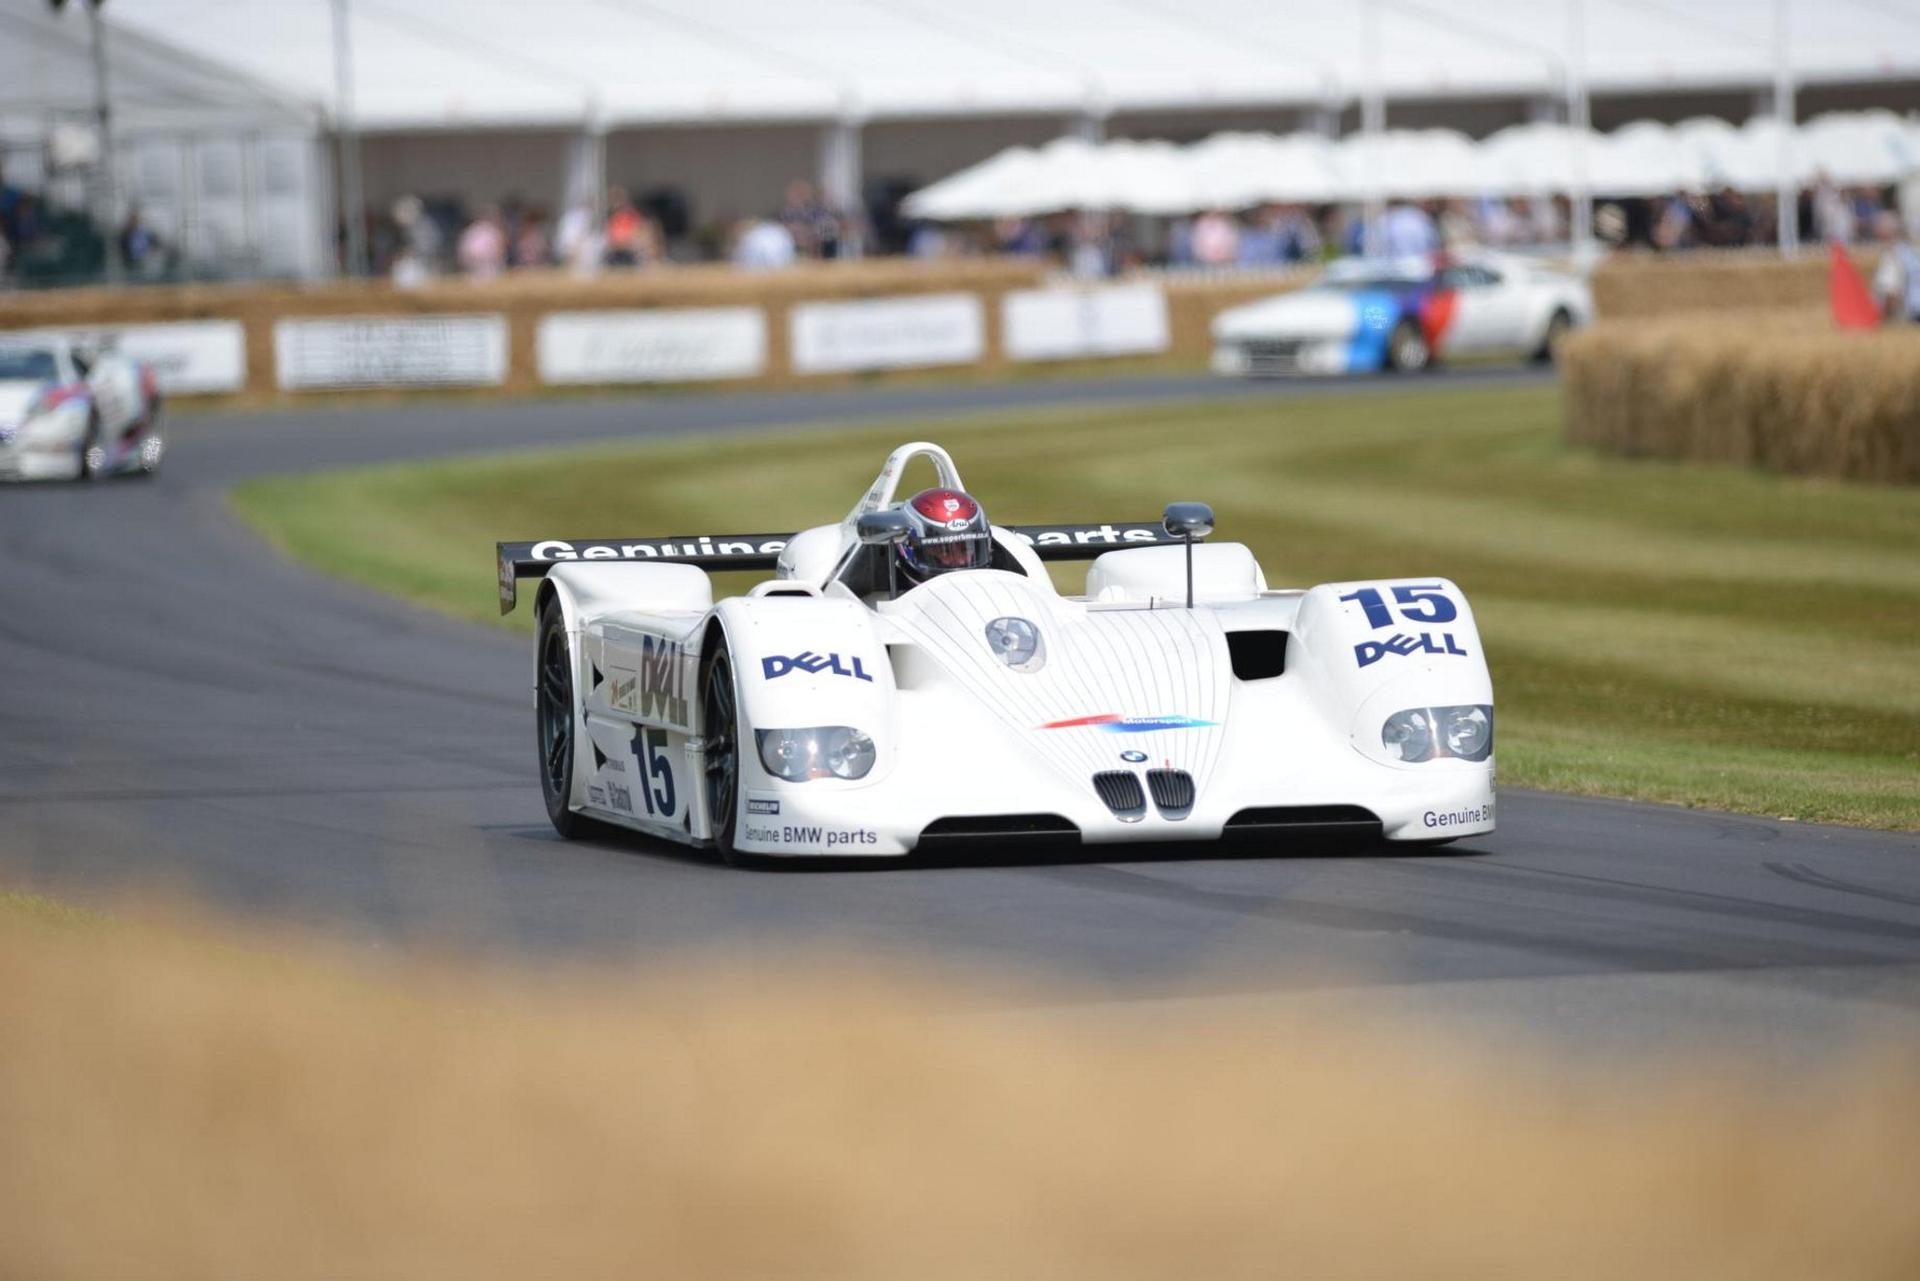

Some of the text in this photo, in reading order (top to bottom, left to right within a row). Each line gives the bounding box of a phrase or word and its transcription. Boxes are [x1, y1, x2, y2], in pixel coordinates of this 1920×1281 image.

[1339, 584, 1457, 630] 15
[761, 650, 874, 682] DELL
[1354, 632, 1468, 668] DELL
[641, 633, 689, 728] DELL
[630, 721, 676, 818] 15
[1423, 807, 1481, 828] Genuine
[783, 826, 822, 843] BMW
[826, 829, 878, 848] parts
